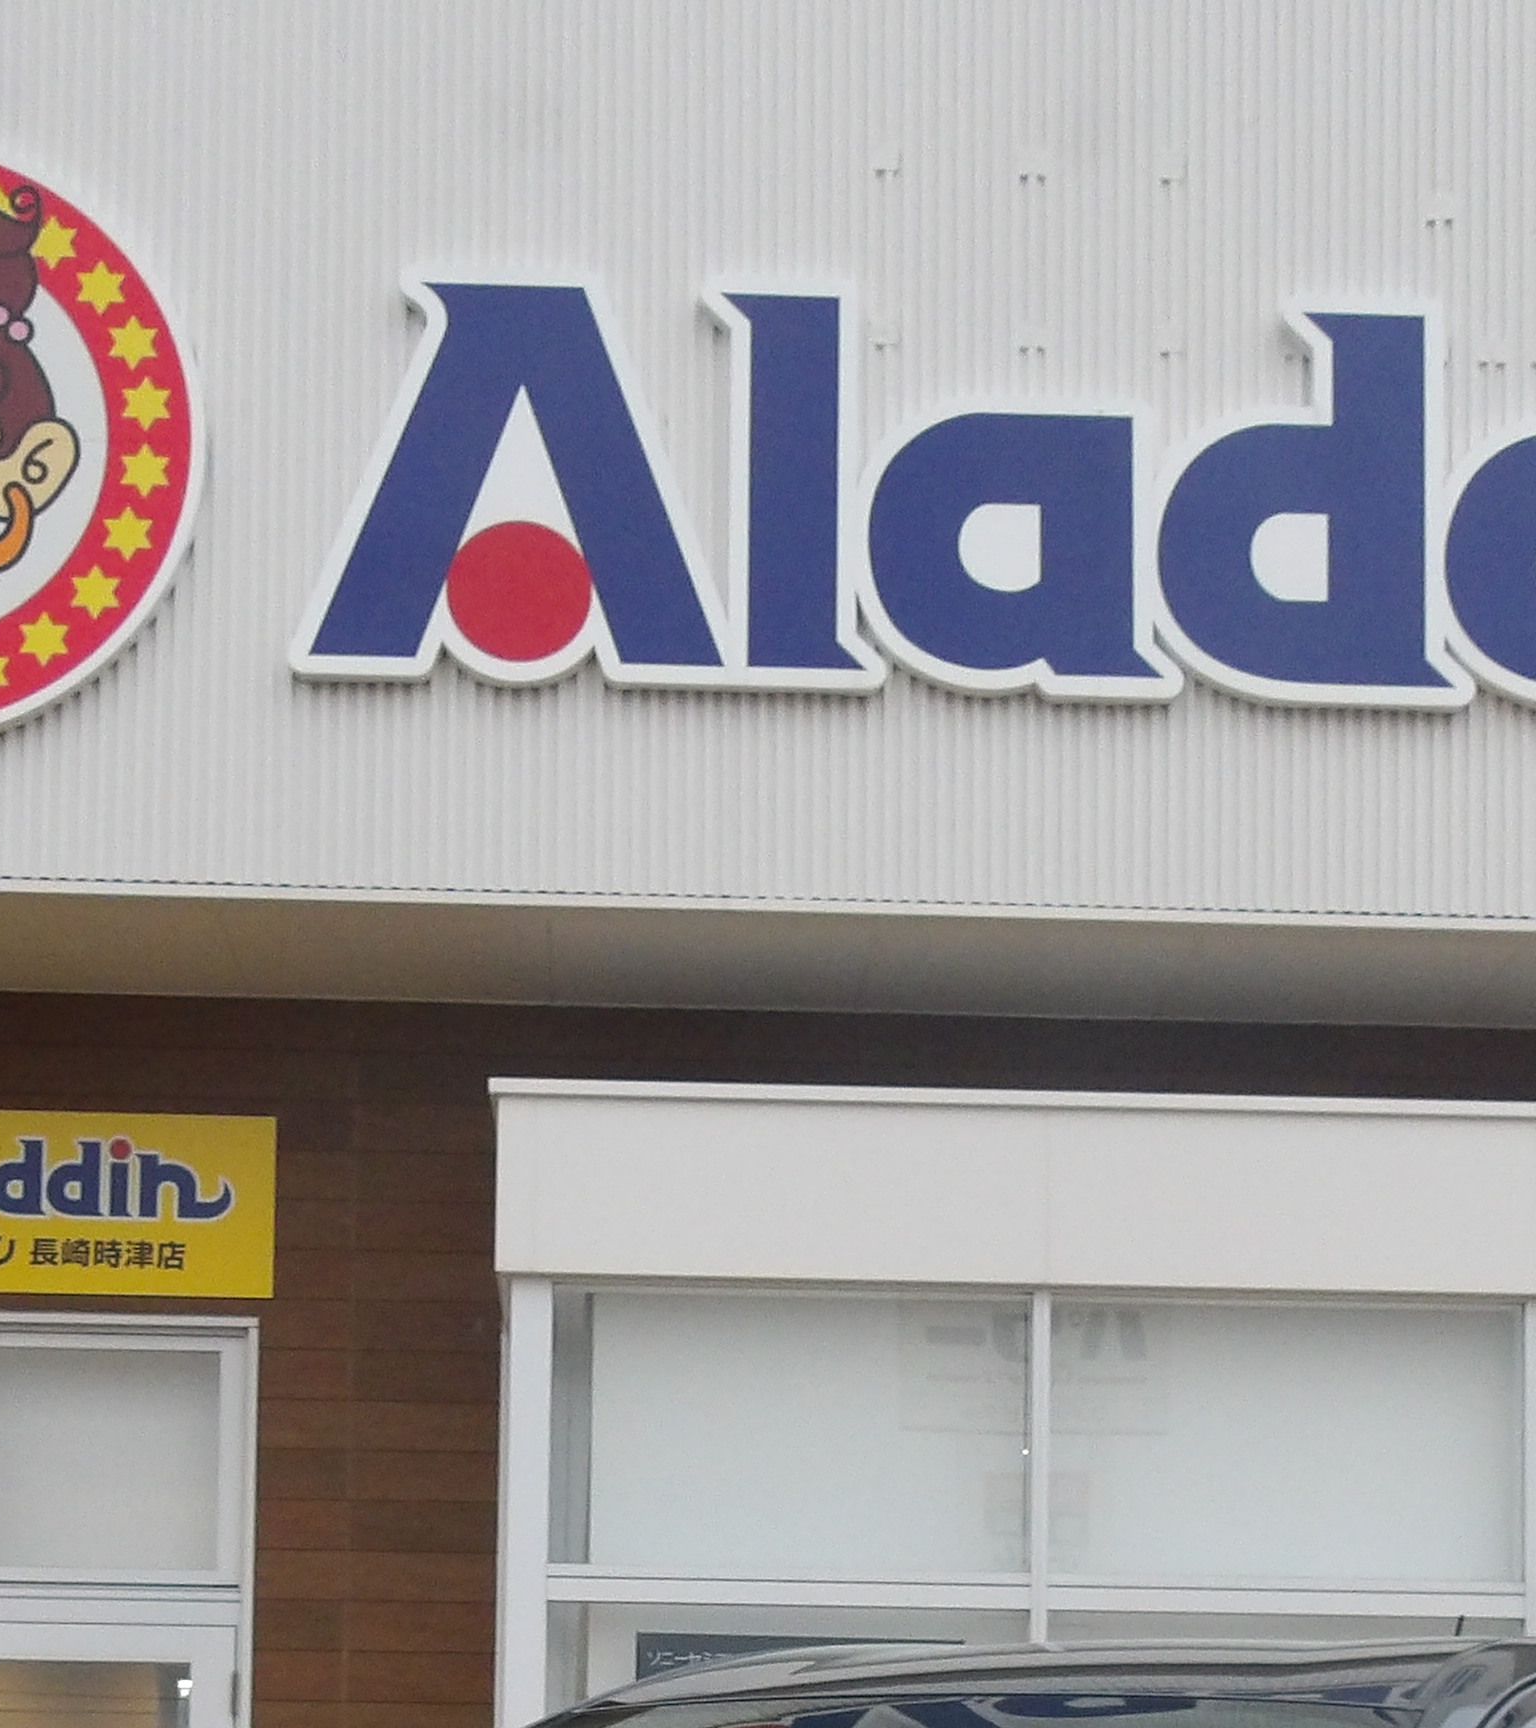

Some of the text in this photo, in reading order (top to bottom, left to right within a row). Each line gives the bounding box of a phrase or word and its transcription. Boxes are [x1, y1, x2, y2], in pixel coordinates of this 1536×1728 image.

[29, 1237, 186, 1270] 長崎時津店
